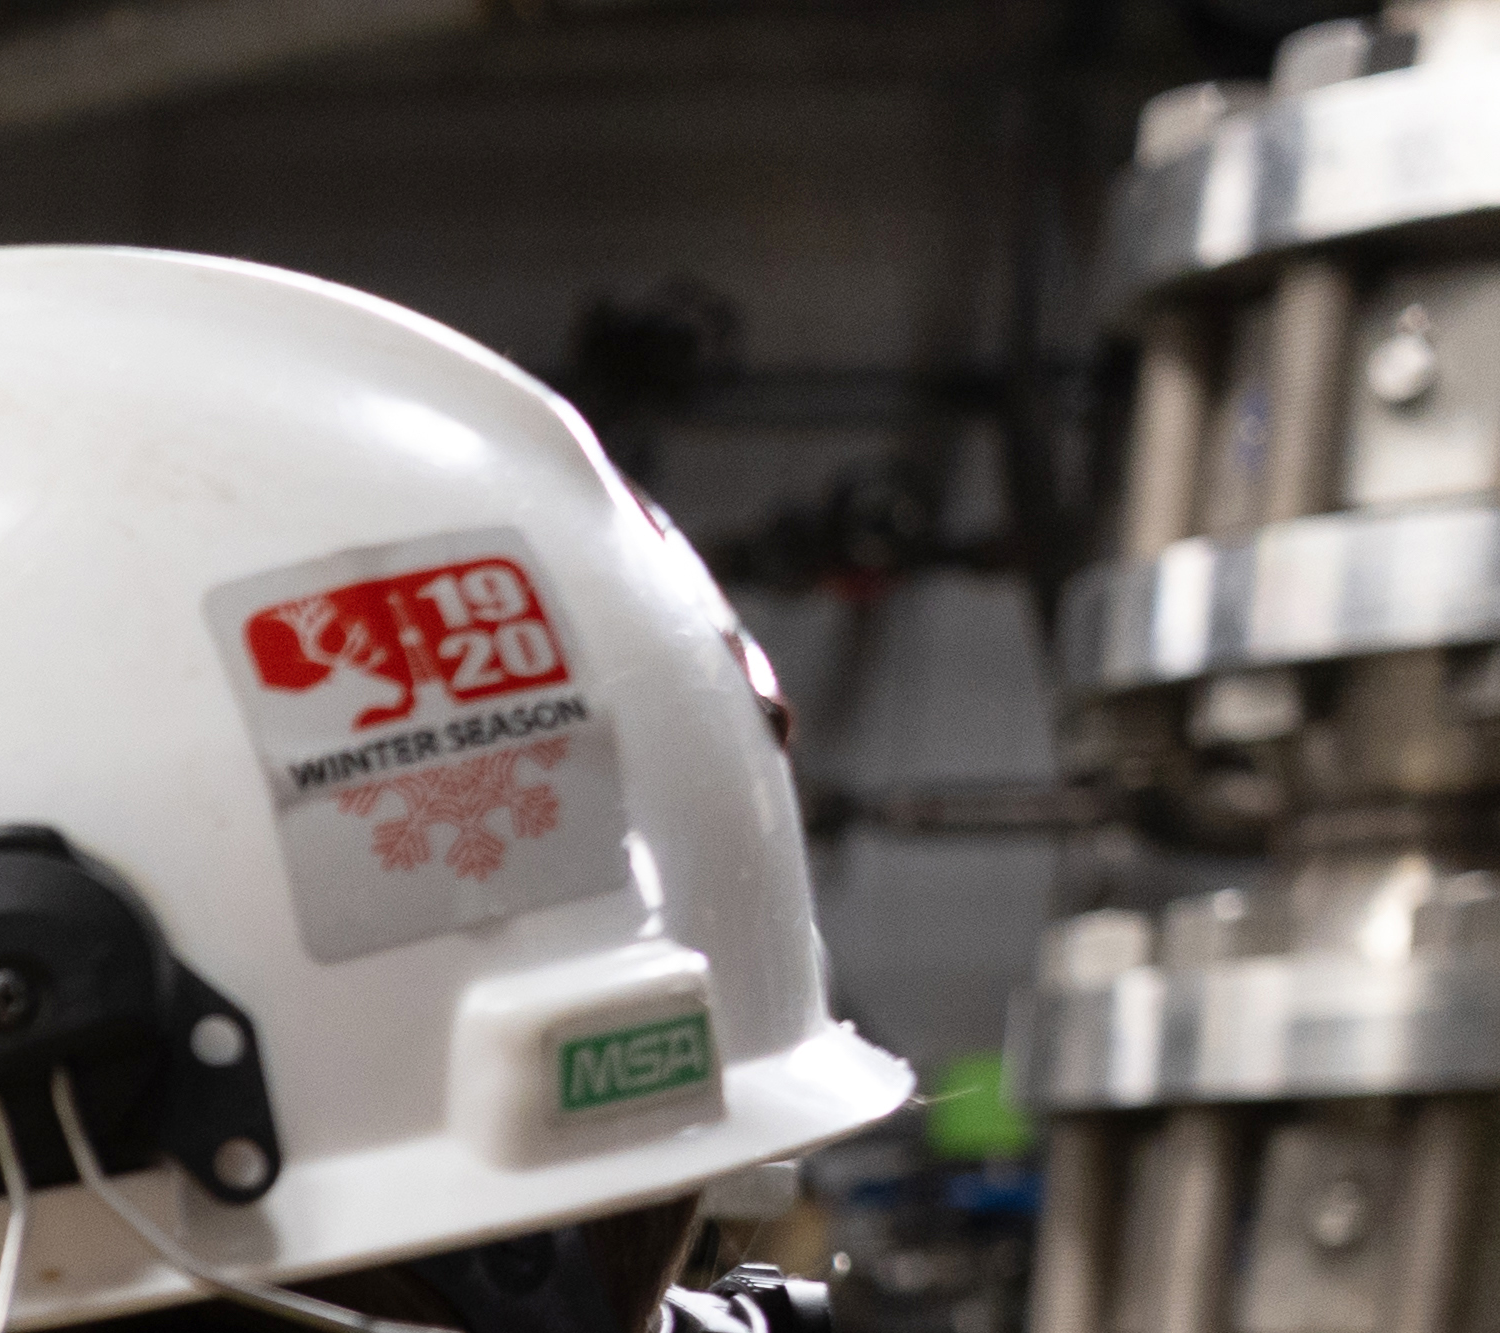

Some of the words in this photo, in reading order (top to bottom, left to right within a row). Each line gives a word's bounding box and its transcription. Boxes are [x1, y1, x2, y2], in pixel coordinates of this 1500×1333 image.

[416, 564, 528, 630] 19
[435, 618, 559, 692] 20
[287, 725, 441, 792] WINTER
[445, 694, 589, 753] SEASON
[566, 1022, 706, 1100] MSA
